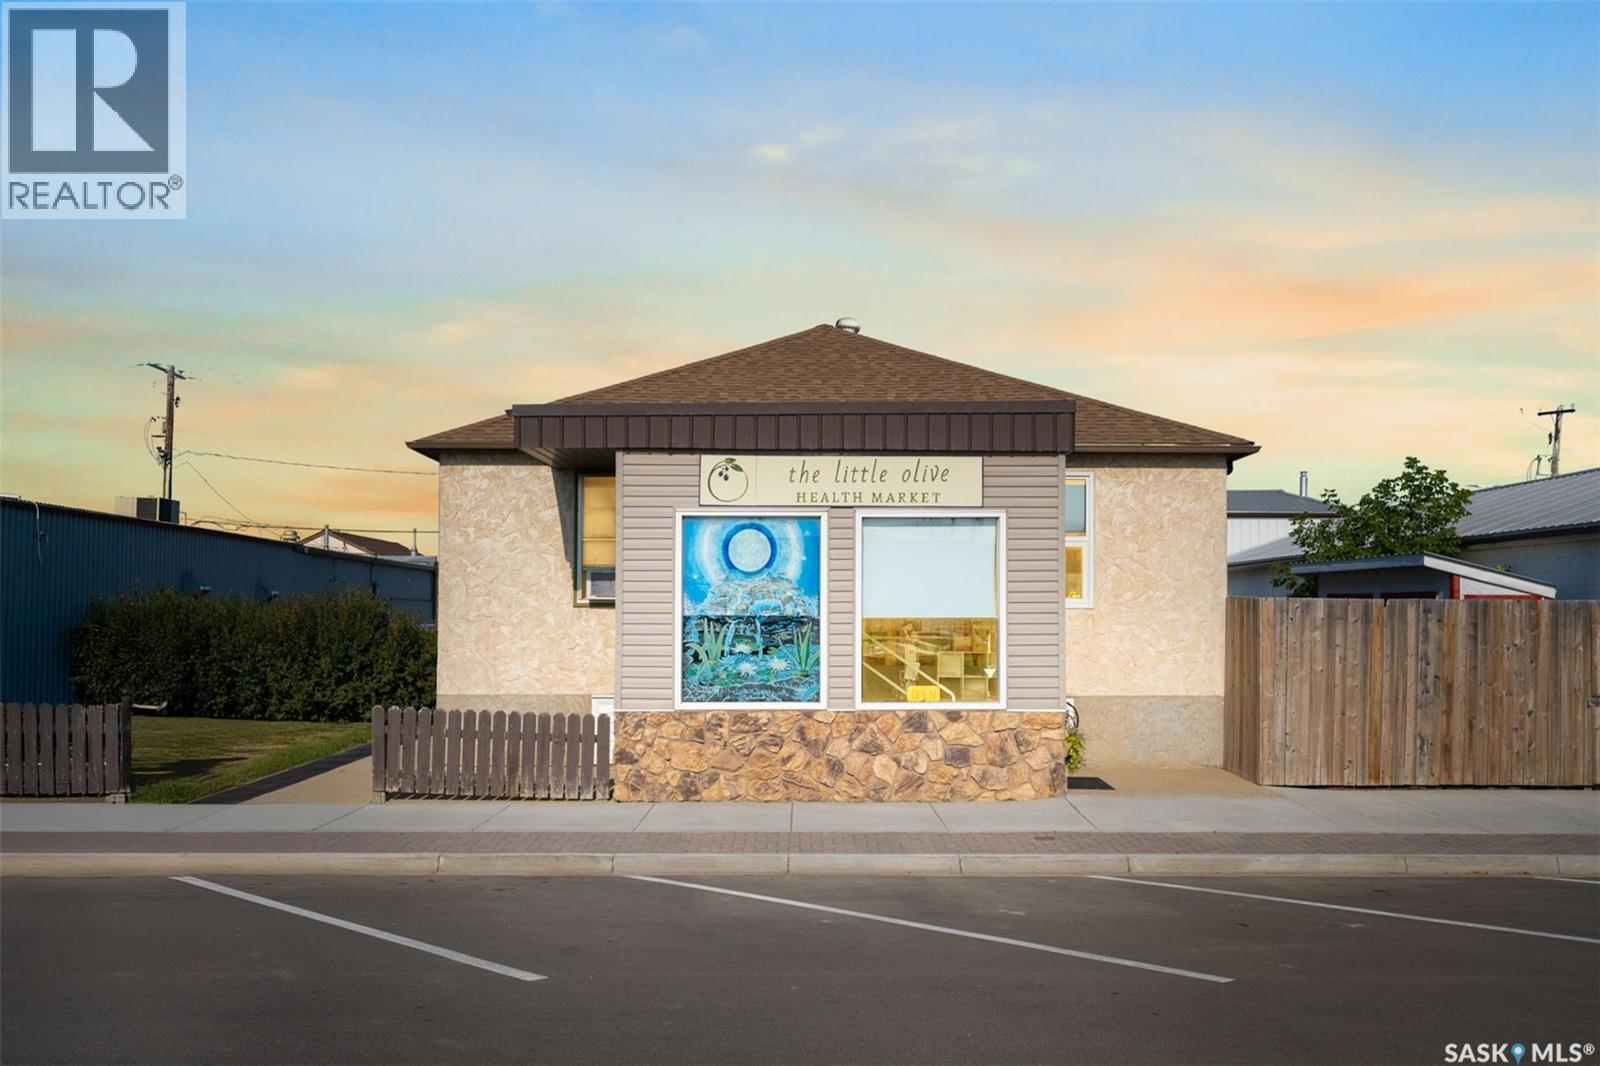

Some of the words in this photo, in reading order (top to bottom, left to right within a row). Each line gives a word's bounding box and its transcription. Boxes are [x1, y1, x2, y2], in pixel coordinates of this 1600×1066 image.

[788, 459, 819, 483] the
[834, 459, 887, 483] little
[901, 458, 950, 483] olive
[796, 491, 863, 503] HEALTH
[871, 491, 941, 504] MARKET
